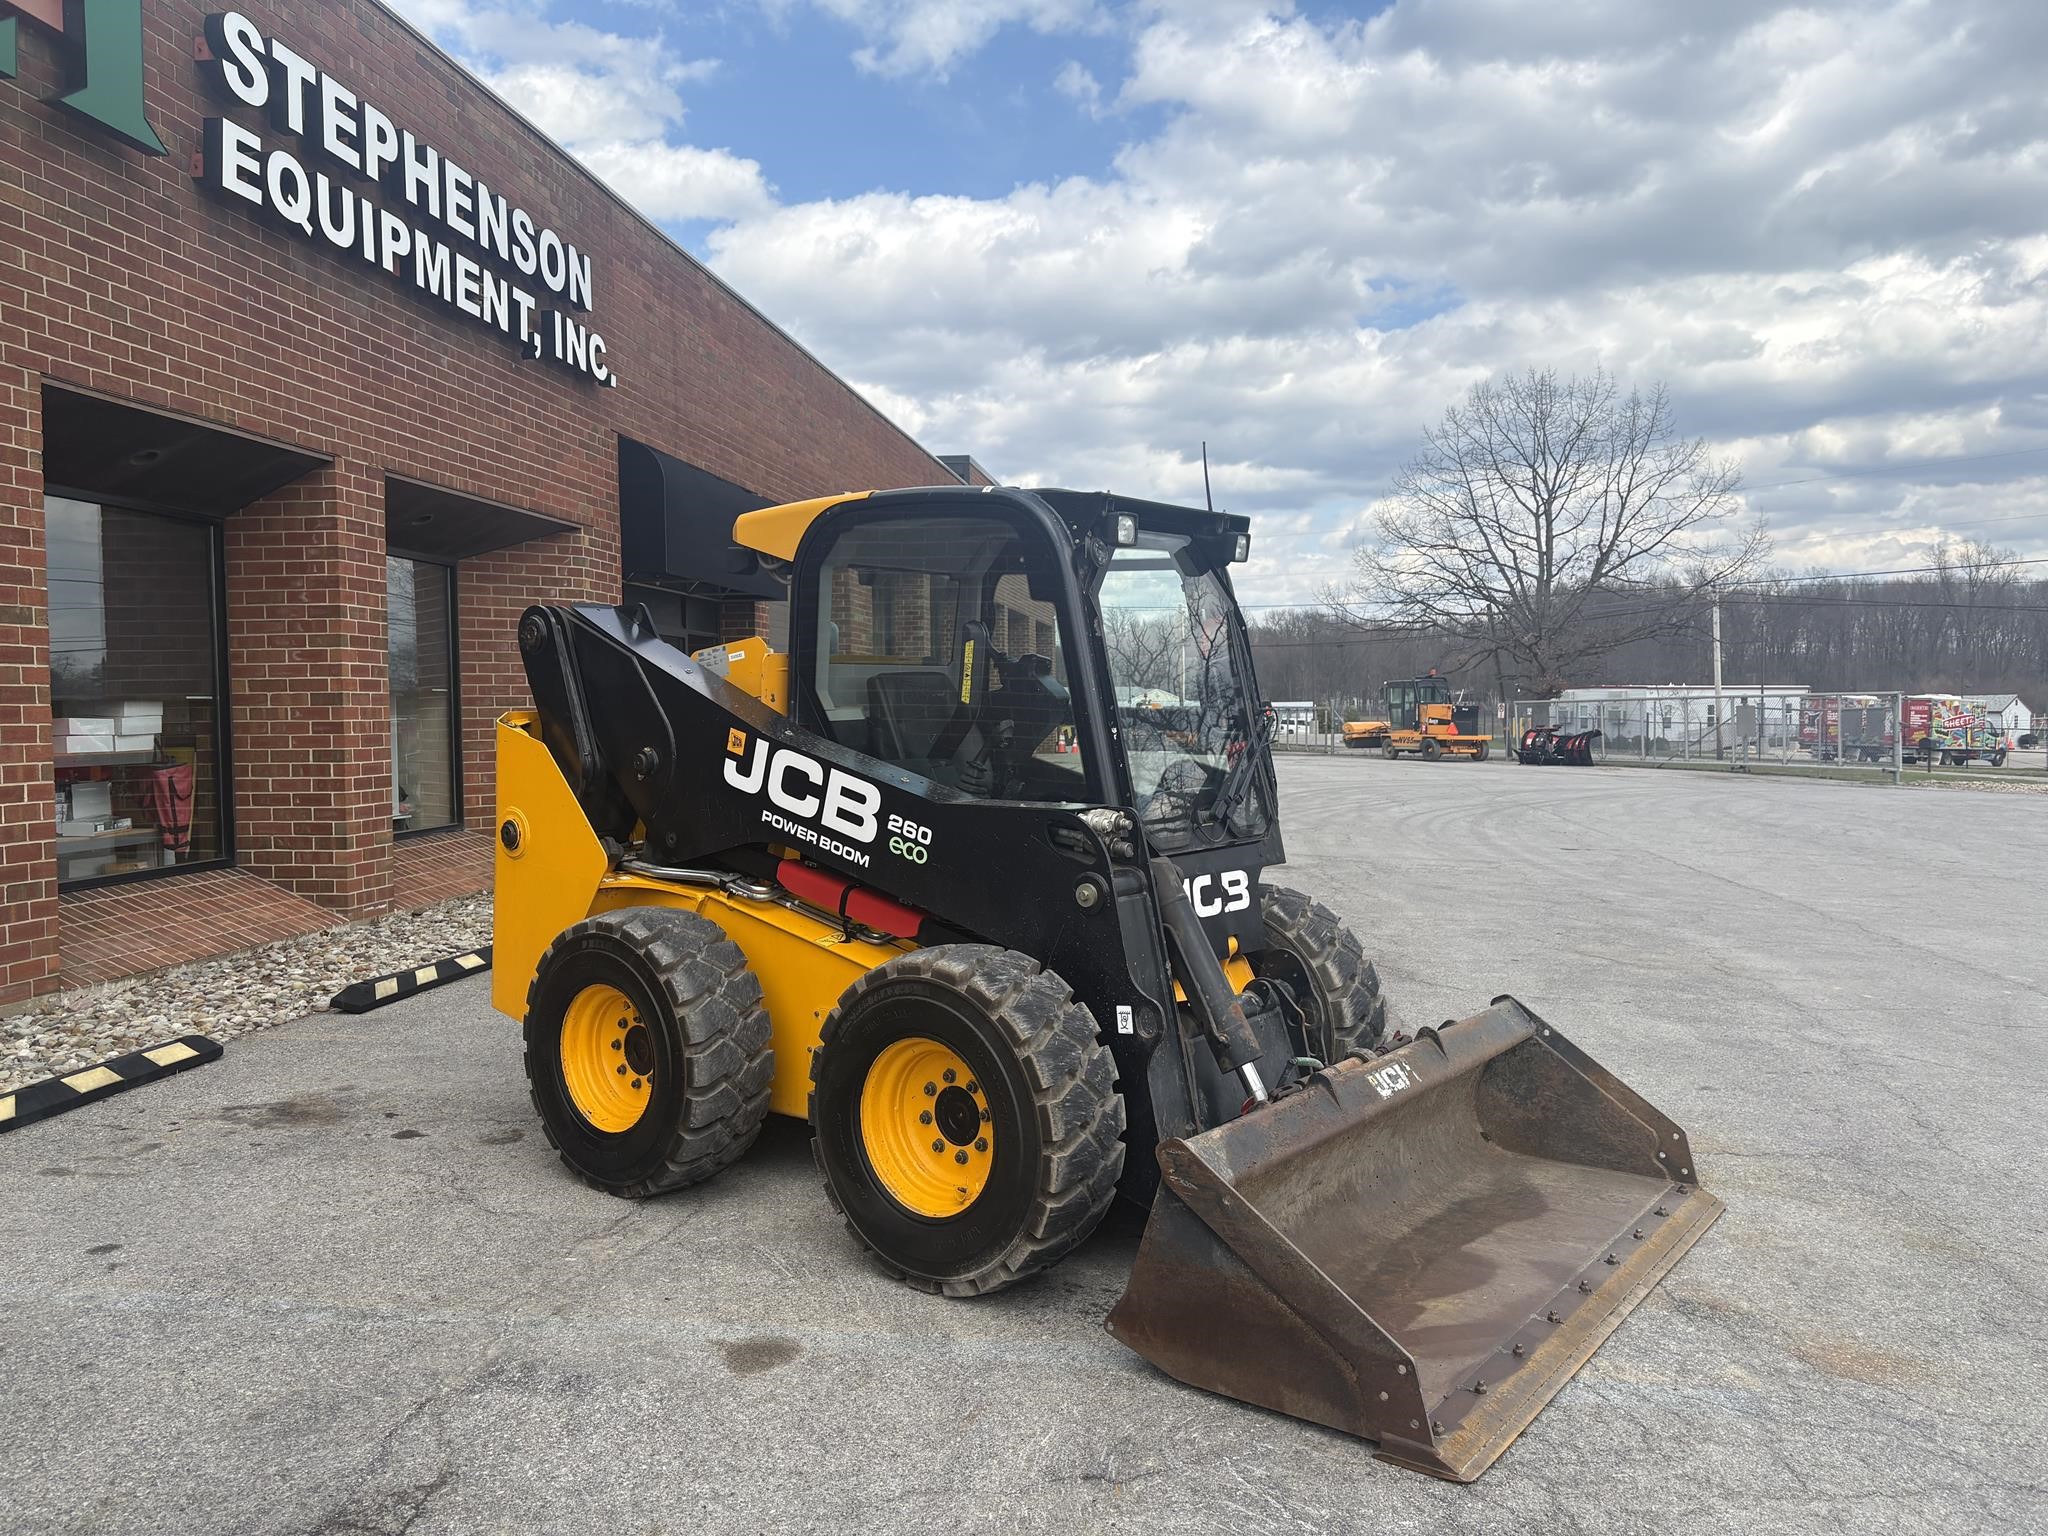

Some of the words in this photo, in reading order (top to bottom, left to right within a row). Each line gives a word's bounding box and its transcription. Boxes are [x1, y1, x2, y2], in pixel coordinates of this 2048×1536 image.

[221, 11, 593, 311] STEPHENSON
[221, 117, 542, 359] EQUIPMENT,
[554, 311, 617, 388] INC.
[723, 738, 882, 843] JCB
[887, 814, 933, 846] 260
[761, 810, 817, 845] POWER
[819, 836, 870, 868] BOOM
[888, 836, 928, 865] eco
